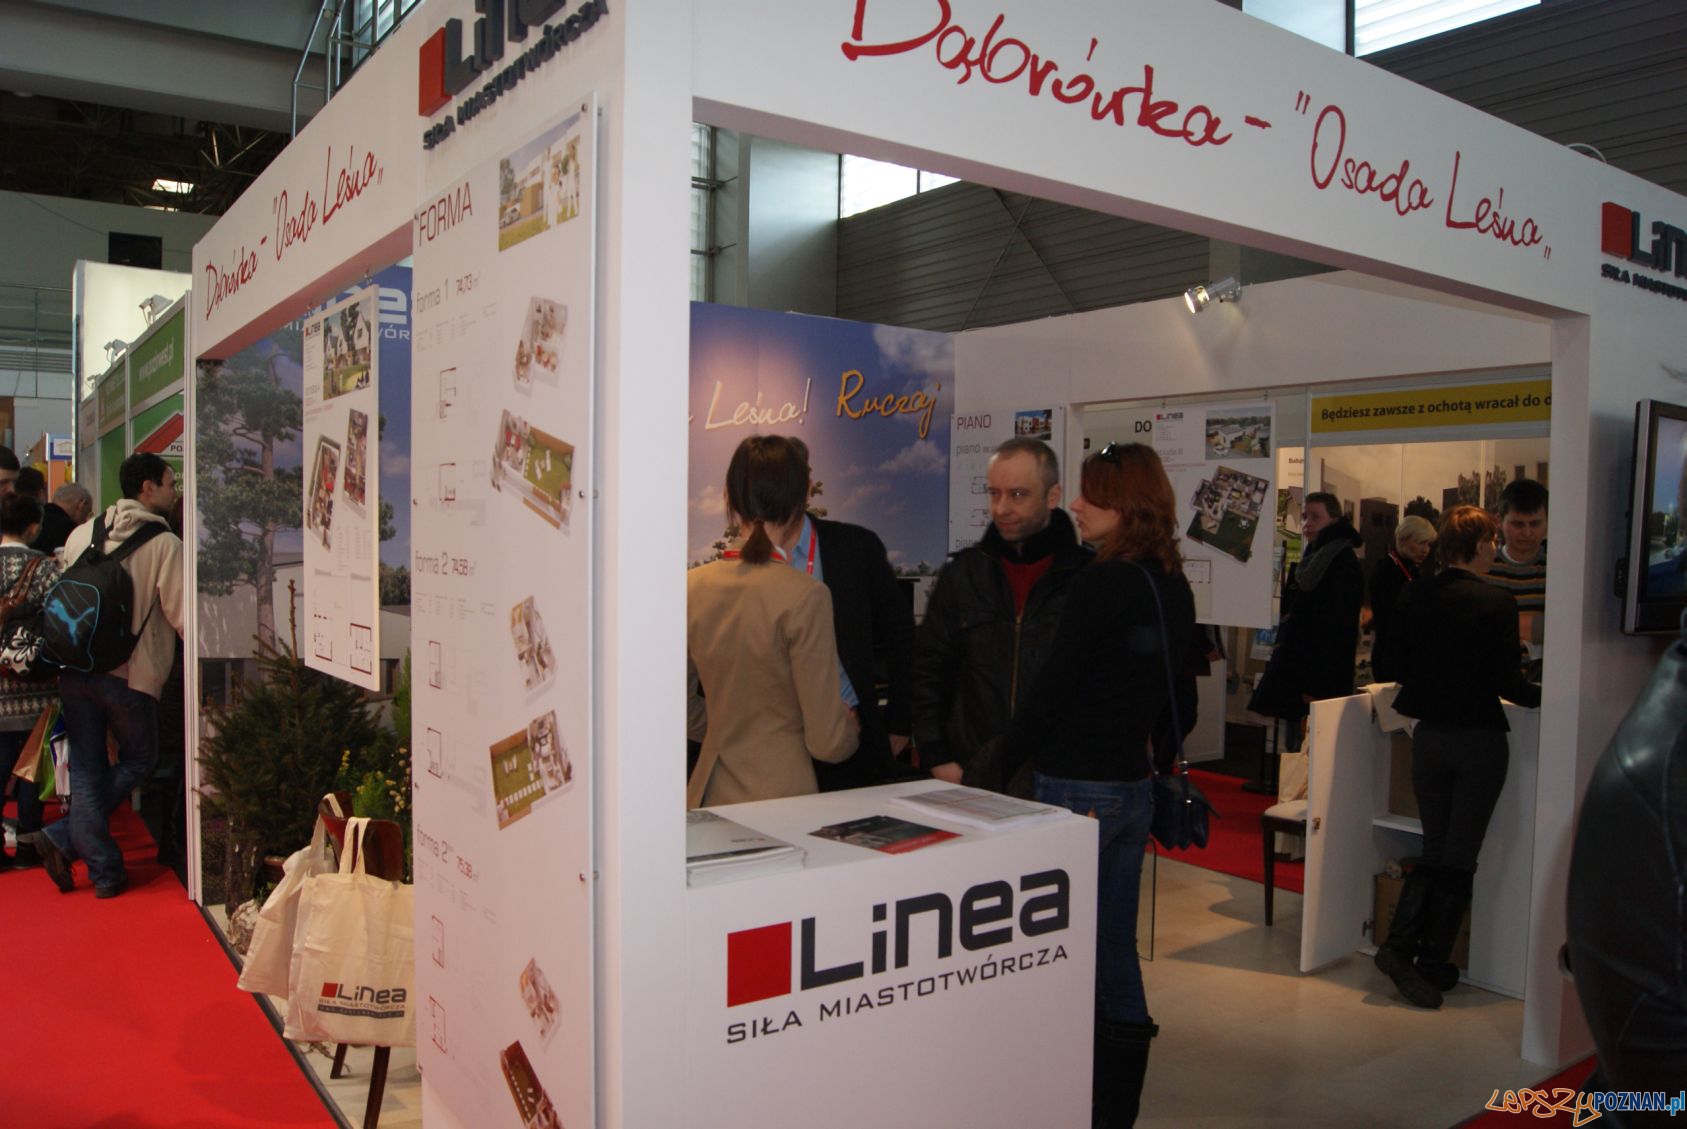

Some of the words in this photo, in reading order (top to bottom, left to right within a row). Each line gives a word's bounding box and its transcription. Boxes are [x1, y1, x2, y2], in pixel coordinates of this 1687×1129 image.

[419, 181, 473, 247] FORMA
[836, 370, 941, 439] Ruczaj
[957, 414, 992, 430] PIANO
[1321, 407, 1370, 422] Będziesz
[1373, 404, 1415, 416] zawsze
[1417, 404, 1424, 413] z
[1427, 399, 1472, 414] ochotą
[1522, 393, 1541, 406] do
[441, 551, 449, 576] 2
[801, 869, 1070, 991] Linea
[337, 983, 407, 1005] Linea
[727, 1010, 802, 1044] SIŁA
[820, 945, 1068, 1022] MIASTOTWÓRCZA
